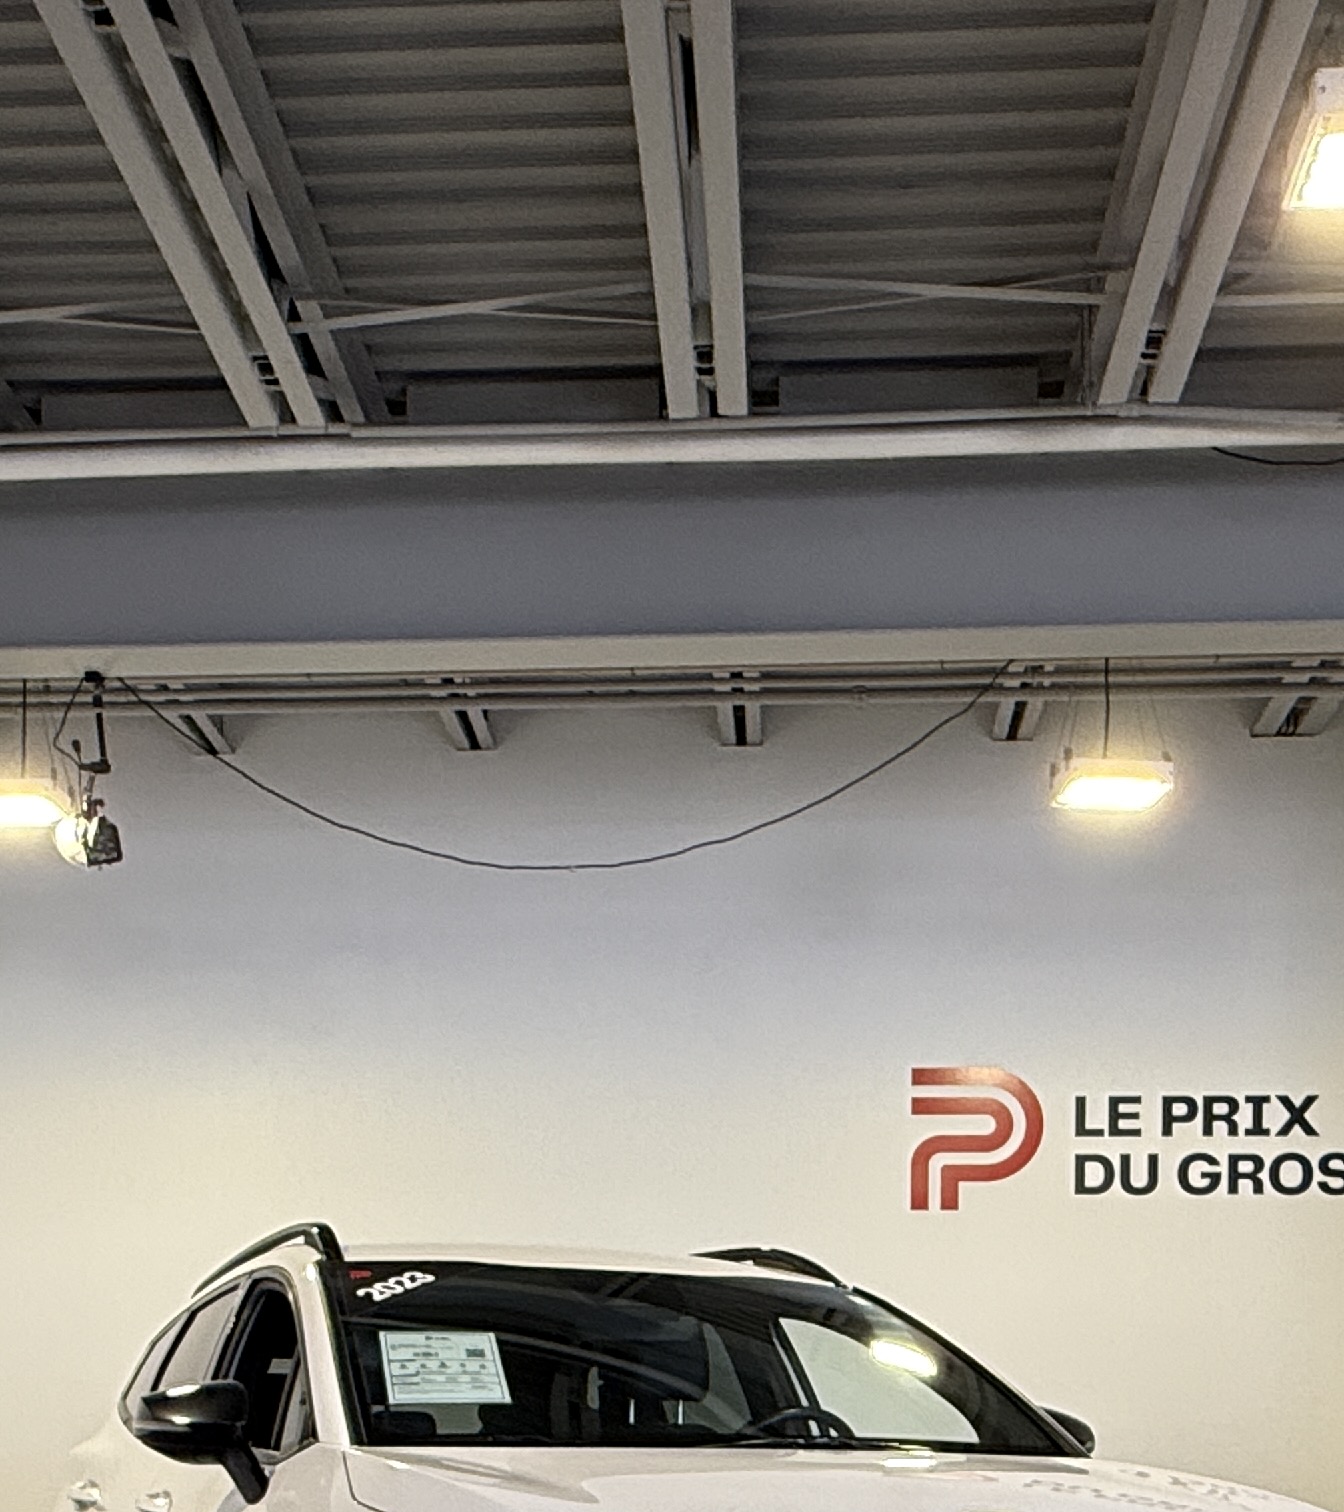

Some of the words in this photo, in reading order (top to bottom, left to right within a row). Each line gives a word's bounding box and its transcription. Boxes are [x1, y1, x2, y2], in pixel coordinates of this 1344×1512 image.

[1074, 1095, 1142, 1138] LE
[1161, 1094, 1320, 1138] PRIX
[1074, 1152, 1159, 1195] DU
